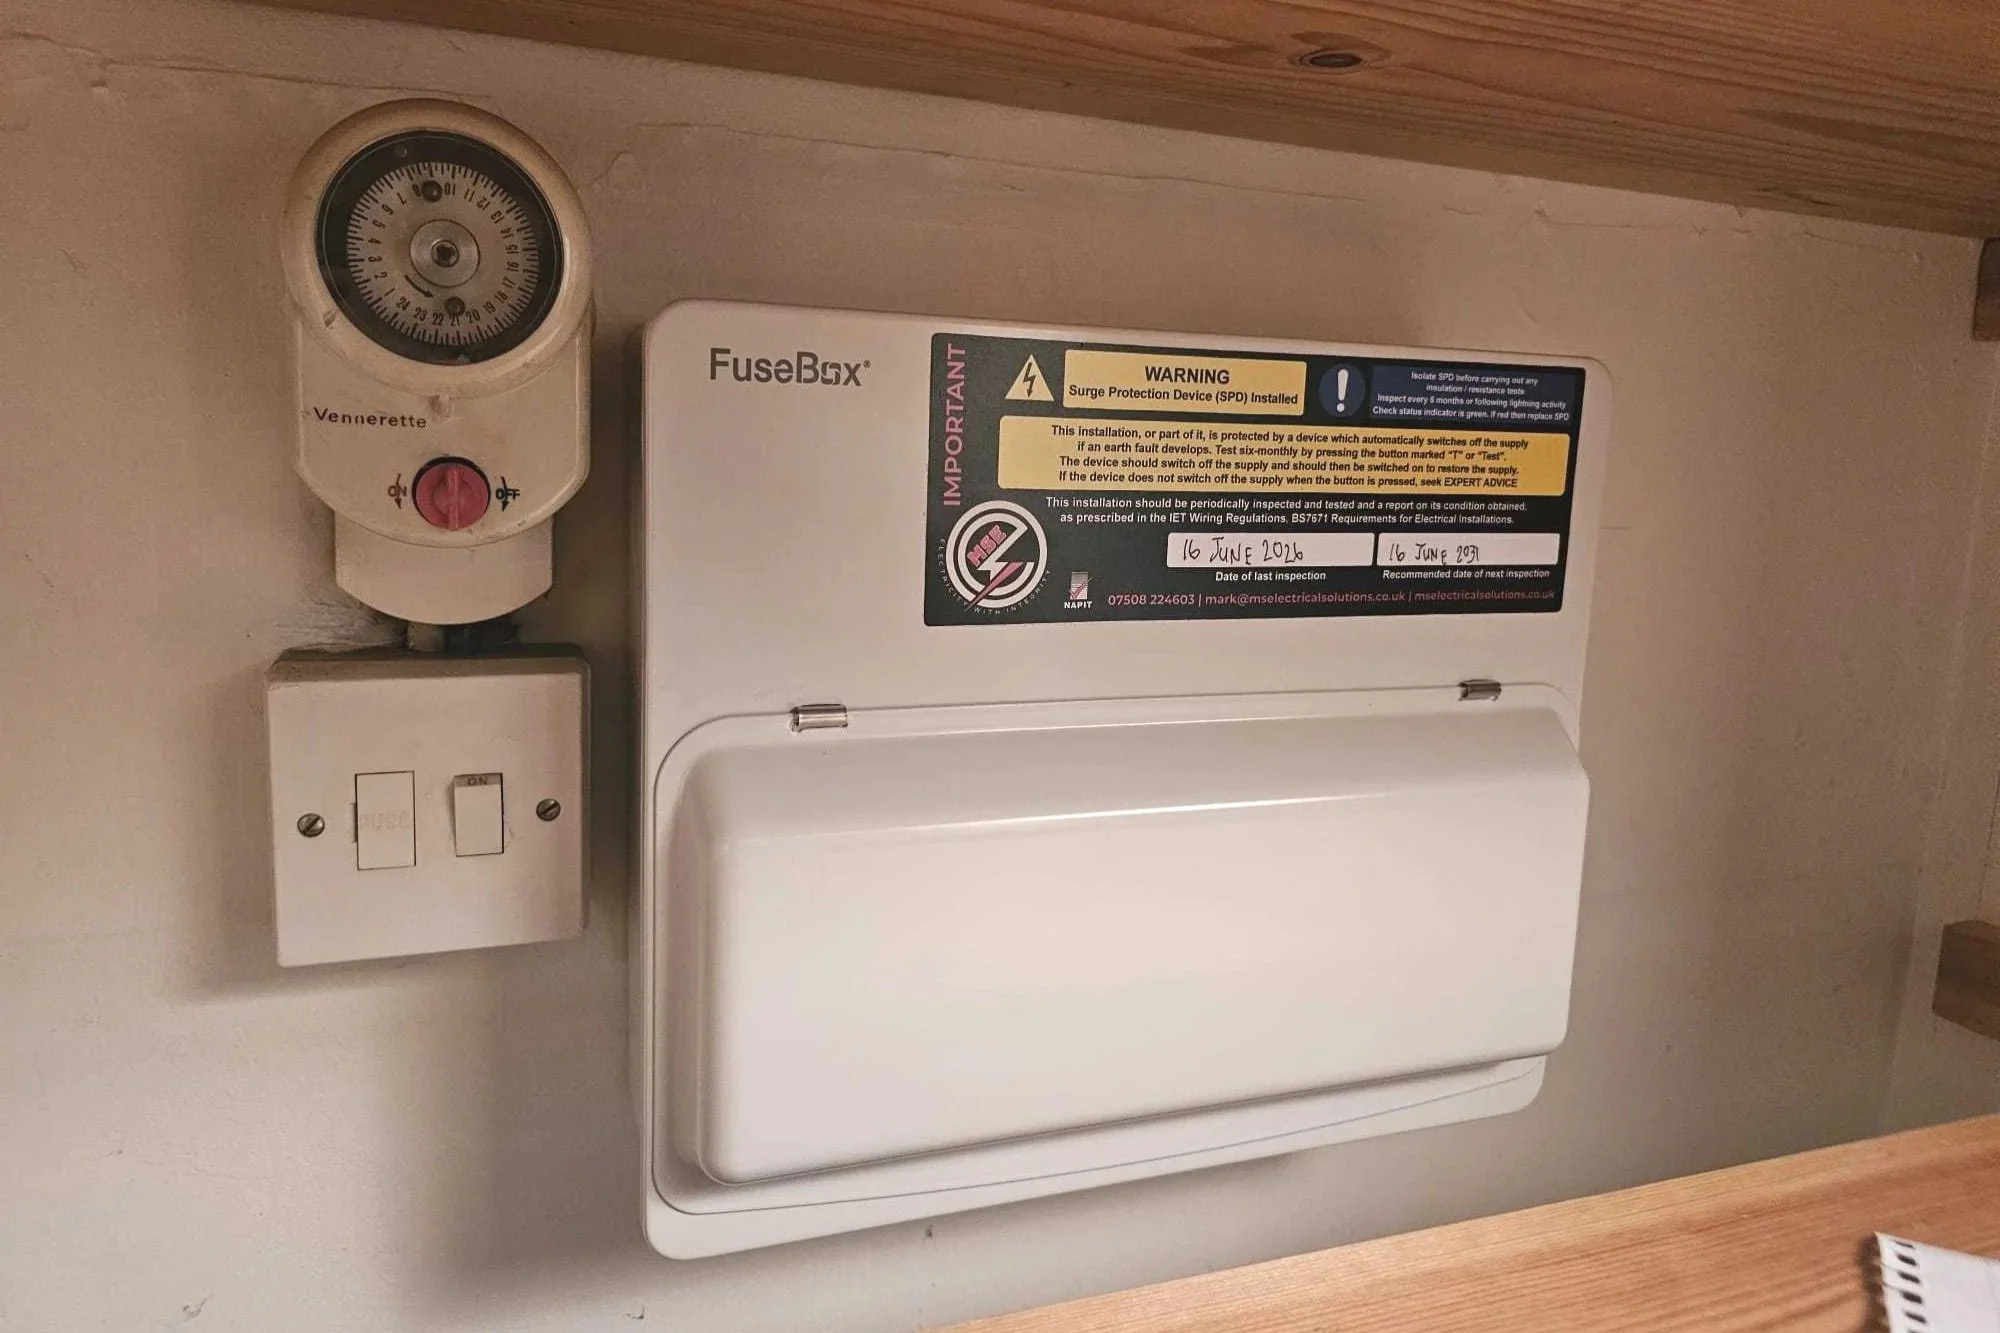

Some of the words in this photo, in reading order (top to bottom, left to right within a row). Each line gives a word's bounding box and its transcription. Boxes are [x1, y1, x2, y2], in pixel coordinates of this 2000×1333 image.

[444, 182, 456, 196] 10
[464, 188, 475, 203] 11
[476, 196, 490, 211] 12
[504, 244, 519, 254] 15
[396, 296, 410, 311] 24
[414, 307, 428, 322] 23
[432, 313, 444, 326] 22
[466, 308, 481, 323] 20
[1144, 365, 1232, 385] WARNING
[1069, 385, 1105, 400] Surge
[1108, 386, 1170, 400] Protection
[1173, 389, 1212, 402] Device
[1215, 390, 1248, 406] (SPD)
[1251, 392, 1298, 405] Installed
[314, 407, 427, 428] Vennerette
[943, 343, 966, 506] IMPORTANT
[1051, 424, 1075, 436] This
[1078, 425, 1142, 440] installation,
[1144, 430, 1157, 439] or
[1158, 429, 1180, 441] part
[1182, 429, 1194, 440] of
[1196, 429, 1206, 442] it,
[1208, 429, 1218, 440] is
[1220, 431, 1270, 443] protected
[1272, 431, 1285, 444] by
[1287, 434, 1294, 442] a
[1296, 432, 1328, 443] device
[1330, 433, 1360, 444] which
[1362, 435, 1425, 448] automatically
[1427, 436, 1467, 446] switches
[1469, 437, 1482, 447] off
[1483, 438, 1498, 447] the
[1499, 439, 1529, 451] supply
[1077, 440, 1086, 452] if
[1087, 441, 1101, 452] an
[1104, 442, 1132, 453] earth
[1135, 442, 1159, 454] fault
[1161, 443, 1212, 457] develops.
[1215, 444, 1237, 455] Test
[1239, 445, 1298, 459] six-monthly
[1301, 446, 1313, 459] by
[1316, 447, 1358, 460] pressing
[1361, 448, 1376, 458] the
[1378, 448, 1409, 459] button
[1411, 450, 1446, 460] marked
[1465, 452, 1475, 460] or
[1059, 455, 1080, 467] The
[1083, 456, 1119, 469] device
[1121, 456, 1158, 468] should
[1161, 458, 1196, 469] switch
[1198, 458, 1213, 470] off
[1215, 458, 1232, 470] the
[1234, 460, 1269, 472] supply
[1271, 460, 1290, 470] and
[1292, 460, 1327, 471] should
[1329, 462, 1350, 472] then
[1353, 461, 1365, 472] be
[1367, 462, 1410, 472] switched
[1412, 465, 1424, 473] on
[1426, 463, 1436, 473] to
[1437, 464, 1470, 474] restore
[1472, 464, 1486, 474] the
[1059, 470, 1067, 482] If
[1069, 471, 1087, 482] the
[1089, 471, 1125, 482] device
[1128, 472, 1154, 483] does
[1157, 473, 1175, 483] not
[1177, 473, 1211, 485] switch
[1214, 473, 1229, 484] off
[1230, 473, 1247, 484] the
[1249, 474, 1284, 487] supply
[1286, 474, 1313, 485] when
[1315, 475, 1331, 485] the
[1333, 475, 1364, 486] button
[1367, 476, 1376, 486] is
[1378, 477, 1418, 488] pressed,
[1420, 477, 1442, 487] seek
[1444, 477, 1482, 487] EXPERT
[1483, 478, 1518, 488] ADVICE
[495, 488, 521, 500] OFF
[1045, 496, 1070, 508] This
[1073, 497, 1132, 508] installation
[1135, 498, 1172, 508] should
[1174, 498, 1188, 508] be
[1190, 498, 1250, 511] periodically
[1253, 499, 1302, 511] inspected
[1304, 499, 1322, 509] and
[1325, 500, 1355, 510] tested
[1357, 499, 1375, 510] and
[1385, 502, 1414, 512] report
[1416, 502, 1428, 510] on
[1430, 501, 1441, 510] its
[1443, 501, 1485, 510] condition
[1060, 514, 1074, 522] as
[1076, 512, 1134, 525] prescribed
[1137, 512, 1147, 523] in
[1149, 512, 1167, 523] the
[1169, 512, 1187, 523] IET
[1189, 512, 1223, 525] Wiring
[1291, 513, 1328, 523] BS7671
[1331, 513, 1397, 525] Requirements
[1399, 514, 1413, 523] for
[1414, 514, 1457, 524] Electrical
[1182, 540, 1201, 560] 16
[1208, 536, 1252, 565] JUNE
[1262, 538, 1304, 563] 2026
[1389, 543, 1405, 562] 16
[1414, 542, 1447, 565] JUNE
[1215, 571, 1239, 582] Date
[1241, 571, 1253, 581] of
[1254, 571, 1273, 581] last
[1275, 571, 1327, 583] inspection
[1383, 569, 1451, 579] Recommended
[1453, 569, 1472, 579] date
[1474, 569, 1484, 578] of
[1485, 570, 1504, 578] next
[1506, 569, 1550, 580] inspection
[1063, 600, 1093, 609] NAPIT
[1108, 592, 1147, 606] 07508
[1150, 592, 1195, 605] 224603
[1205, 591, 1406, 607] mark@mselectricalsolutions.co.uk
[467, 776, 488, 786] ON
